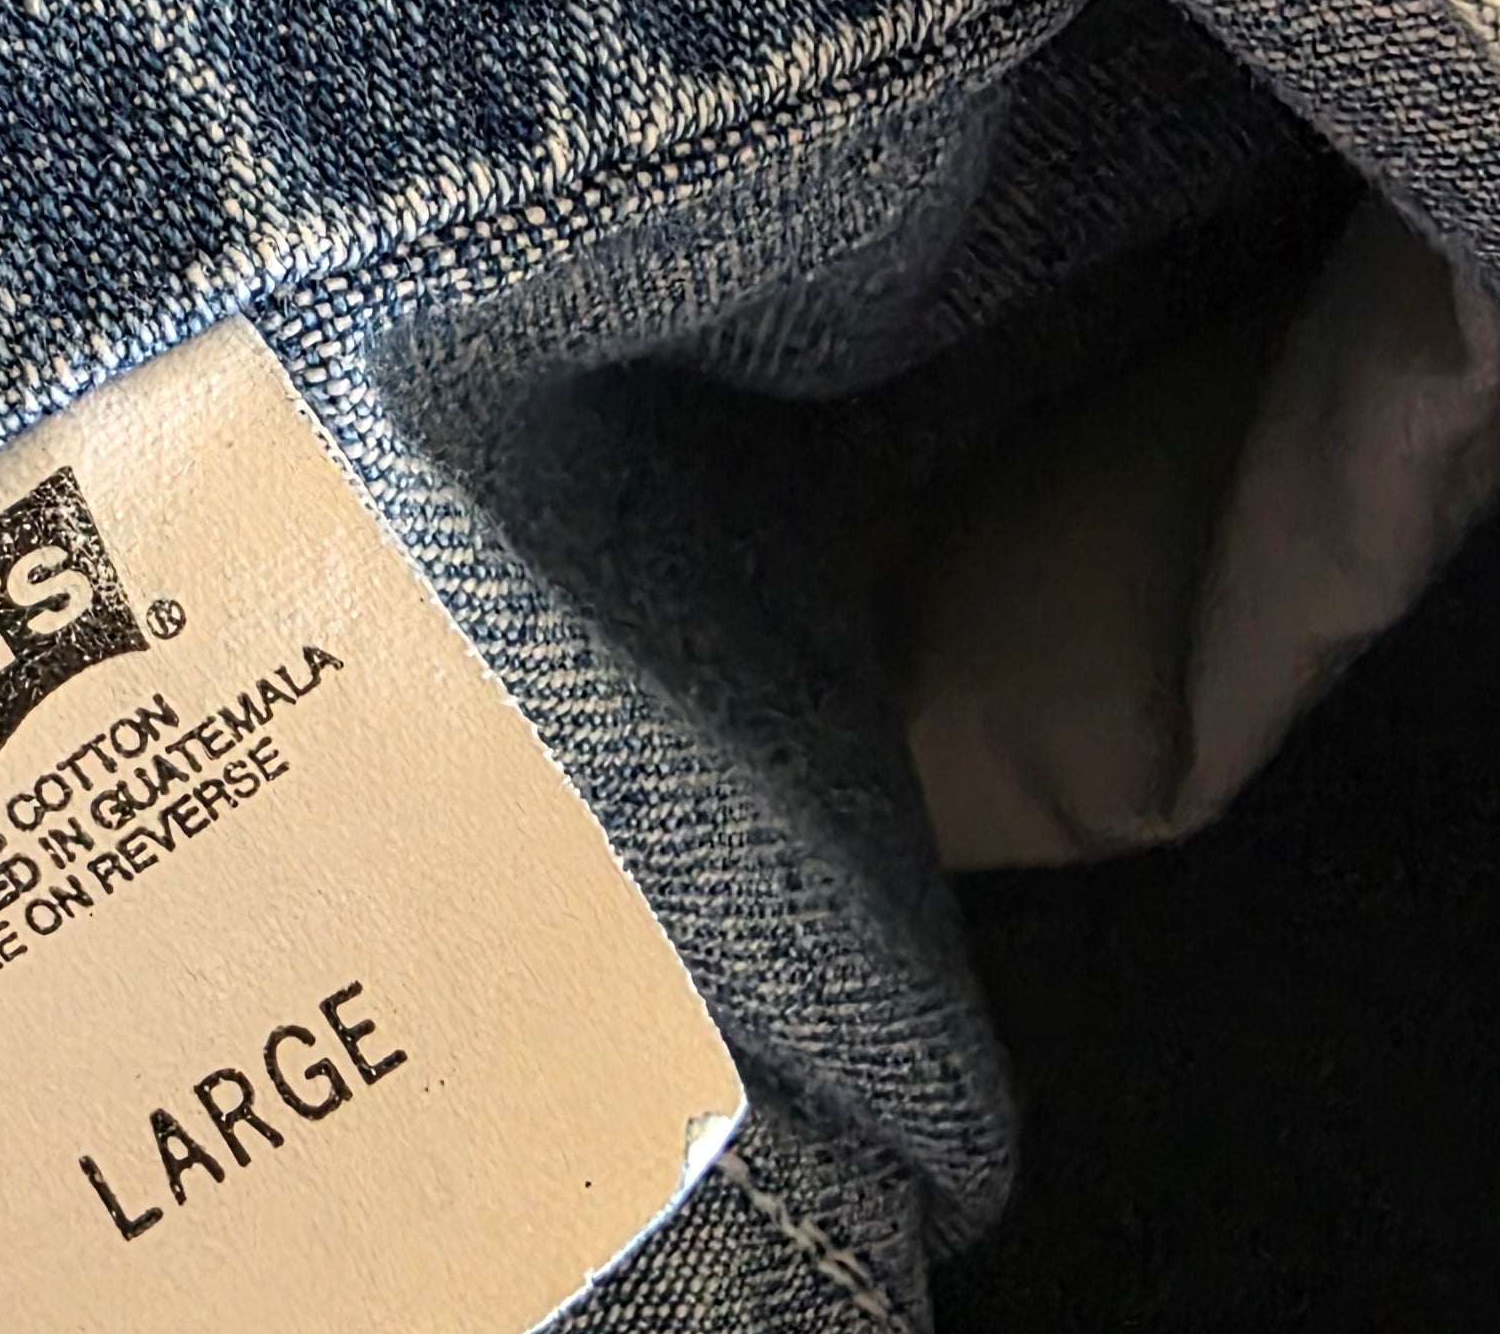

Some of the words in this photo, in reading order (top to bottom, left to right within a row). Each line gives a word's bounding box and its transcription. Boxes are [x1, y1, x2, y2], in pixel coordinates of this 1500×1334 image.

[6, 693, 180, 832] COTTON
[25, 875, 94, 936] ON
[88, 737, 290, 894] REVERSE
[38, 817, 95, 869] IN
[91, 646, 344, 831] GUATEMALA
[78, 980, 408, 1242] LARGE
